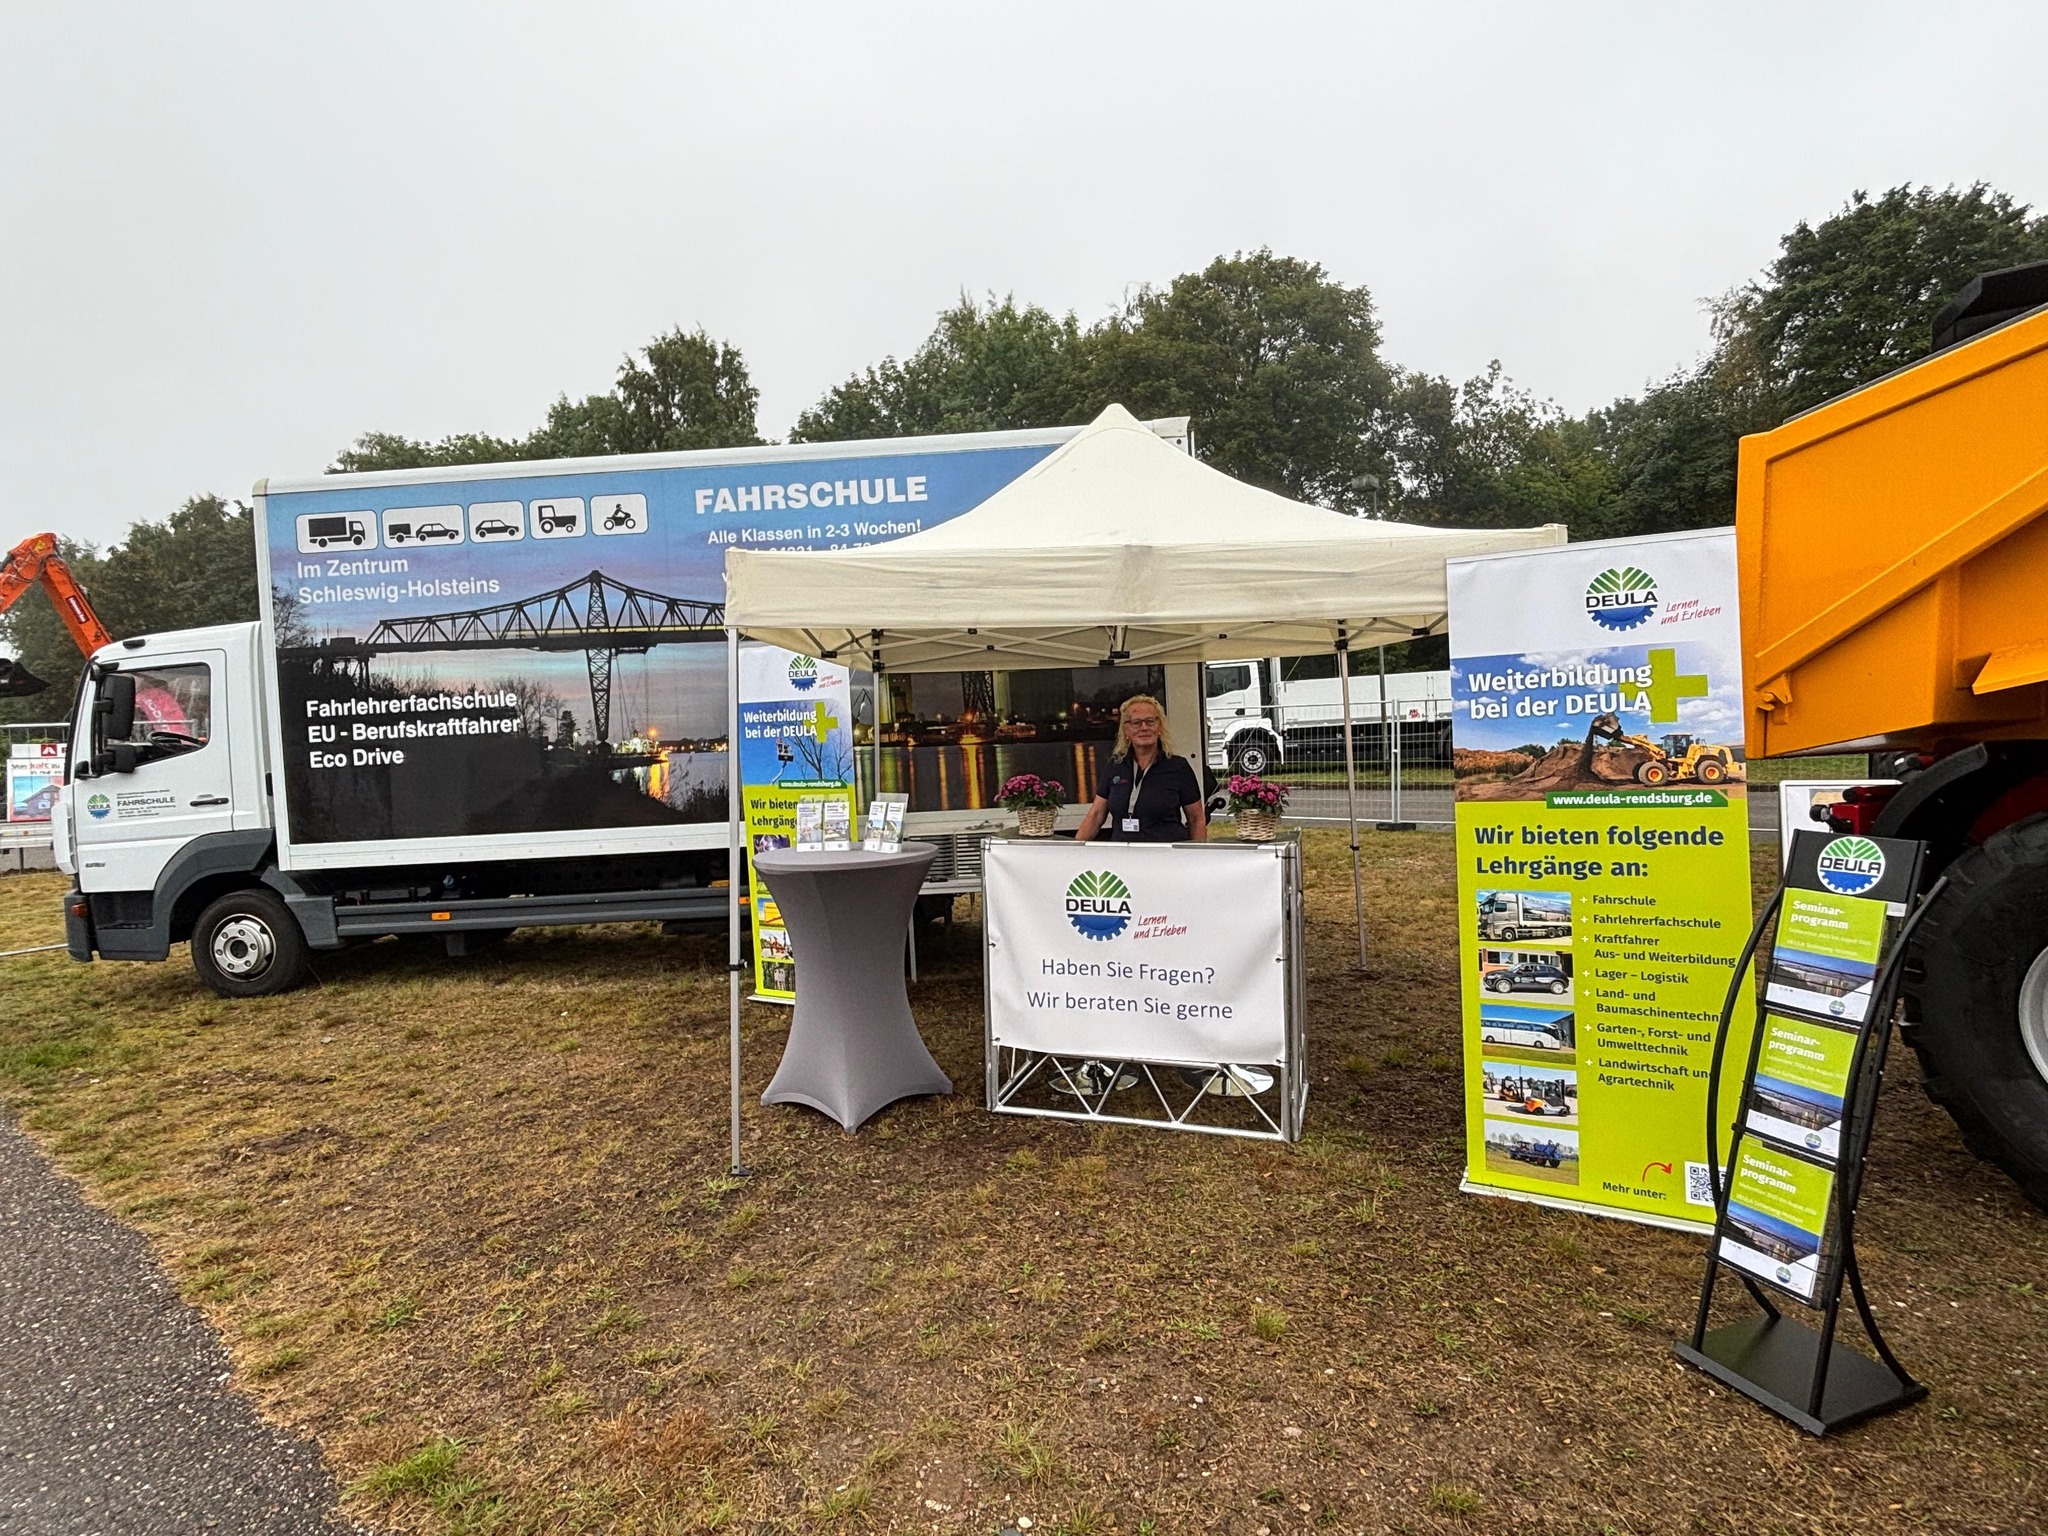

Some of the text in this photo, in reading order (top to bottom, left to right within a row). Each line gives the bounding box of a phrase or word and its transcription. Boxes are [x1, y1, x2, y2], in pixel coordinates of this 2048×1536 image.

[694, 475, 928, 514] FAHRSCHULE
[707, 518, 921, 544] Alle Klassen in 2-3 Wochen!
[297, 558, 409, 579] Im Zentrum
[298, 576, 501, 605] Schleswig-Holsteins
[1585, 590, 1659, 608] DEULA
[1660, 606, 1722, 625] und Erleben
[1665, 599, 1700, 613] Lernen
[788, 669, 818, 678] DEULA
[1468, 664, 1653, 693] Weiterbildung
[306, 690, 518, 718] Fahrlehrerfachschule
[1470, 691, 1653, 719] bei der DEULA
[743, 709, 818, 723] Weiterbildung
[308, 724, 336, 743] EU
[352, 716, 521, 741] Berufskraftfahrer
[745, 724, 818, 738] bei der DEULA
[309, 748, 405, 769] Eco Drive
[117, 796, 176, 807] FAHRSCHULE
[750, 797, 767, 809] Wir
[768, 797, 798, 810] bieten
[1553, 791, 1713, 806] www.deula-rendsburg.de
[1474, 824, 1725, 850] Wir bieten folgende
[1476, 855, 1649, 880] Lehrgänge an:
[1819, 856, 1882, 875] DEULA
[1065, 898, 1133, 914] DEULA
[1592, 894, 1657, 906] Fahrschule
[1792, 900, 1845, 916] Seminar-
[1137, 915, 1168, 927] Lernen
[1593, 914, 1722, 929] Fahrlehrerfachschule
[1790, 913, 1850, 930] programm
[1133, 925, 1188, 940] und Erleben
[1594, 933, 1660, 946] Kraftfahrer
[1594, 949, 1737, 968] Aus- und Weiterbildung
[1042, 957, 1216, 986] Haben Sie Fragen?
[1595, 968, 1628, 981] Lager
[1640, 970, 1690, 985] Logistik
[1596, 987, 1656, 1002] Land- und
[1026, 991, 1233, 1021] Wir beraten Sie gerne
[1596, 1003, 1727, 1023] Baumaschinentechni
[1596, 1022, 1711, 1043] Garten-, Forst- und
[1771, 1027, 1821, 1046] Seminar-
[1597, 1038, 1689, 1056] Umwelttechnik
[1768, 1040, 1825, 1062] programm
[1598, 1057, 1711, 1079] Landwirtschaft un
[1598, 1073, 1675, 1091] Agrartechnik
[1742, 1154, 1793, 1177] Seminar-
[1739, 1167, 1797, 1194] programm
[1602, 1181, 1667, 1201] Mehr unter:
